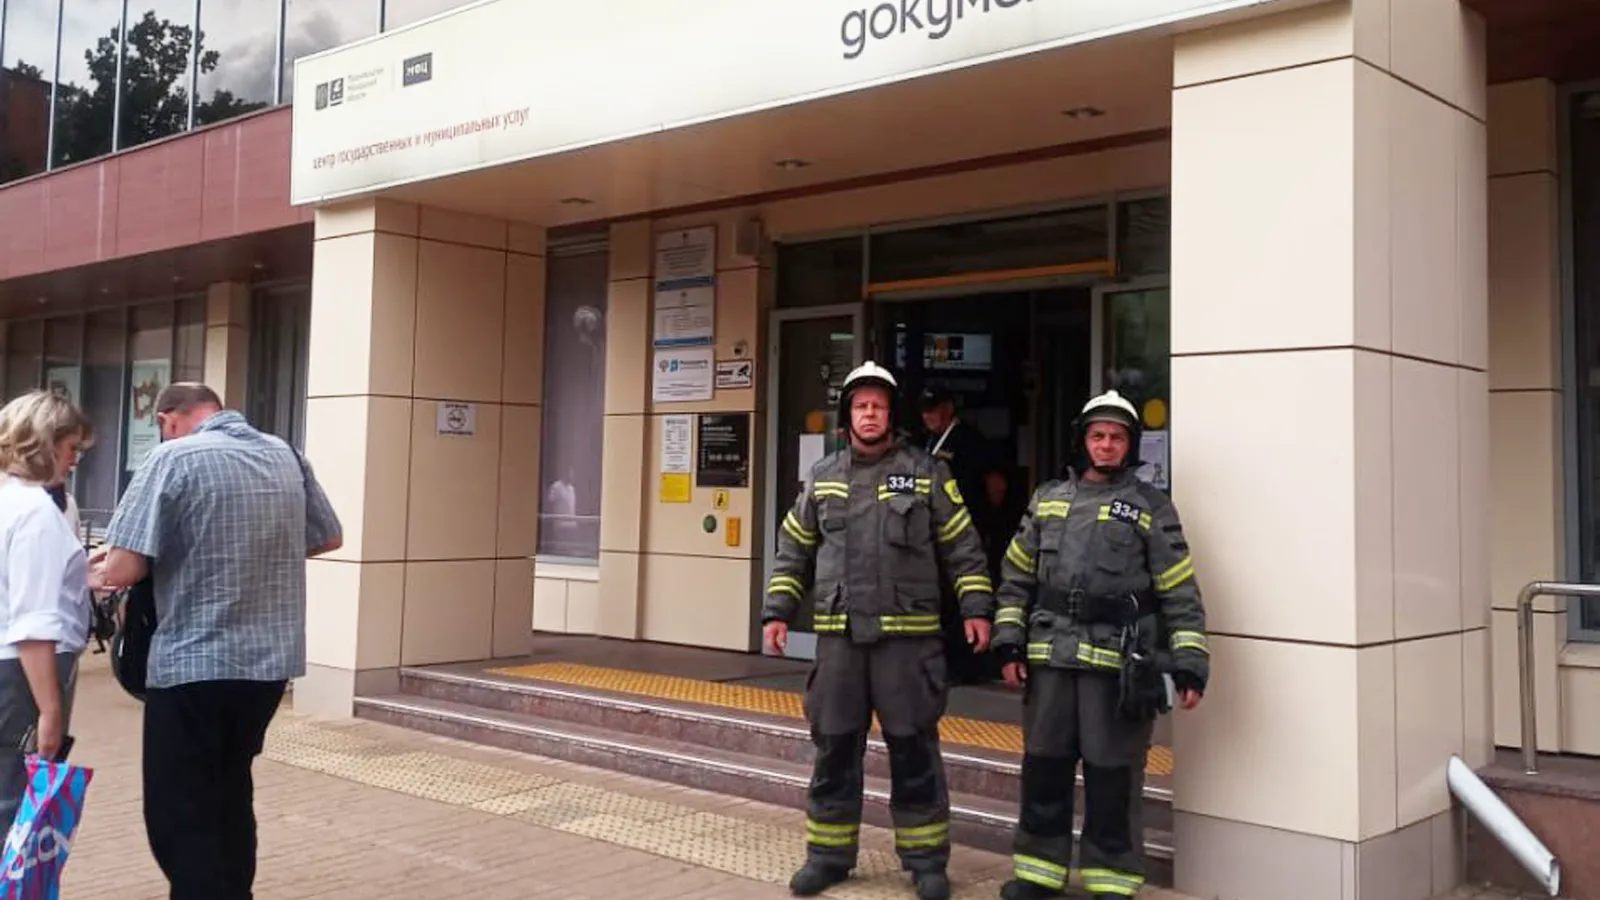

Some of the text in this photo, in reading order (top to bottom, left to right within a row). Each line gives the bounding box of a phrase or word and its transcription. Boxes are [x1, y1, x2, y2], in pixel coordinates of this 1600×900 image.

[338, 136, 413, 165] государственных
[423, 115, 501, 147] муниципальных
[503, 107, 530, 131] услуг
[889, 475, 914, 490] 334
[1112, 501, 1139, 520] 334
